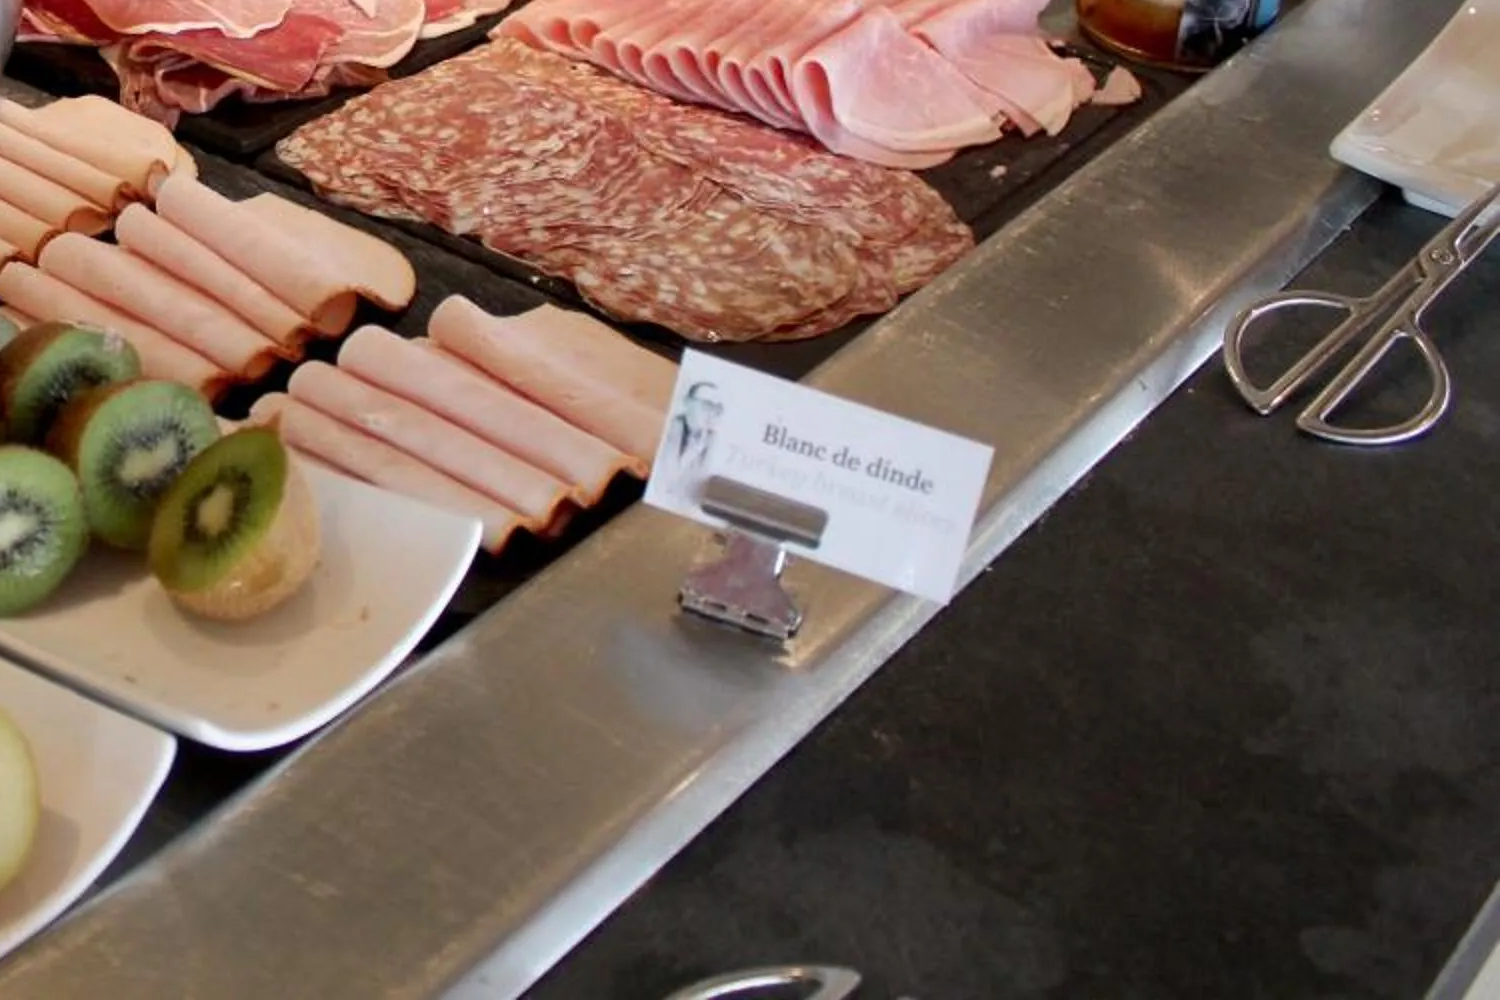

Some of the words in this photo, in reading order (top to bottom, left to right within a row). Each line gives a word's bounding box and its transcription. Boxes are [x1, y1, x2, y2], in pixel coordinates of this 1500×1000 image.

[761, 423, 828, 462] Blanc
[832, 446, 863, 472] de
[865, 456, 935, 496] dinde
